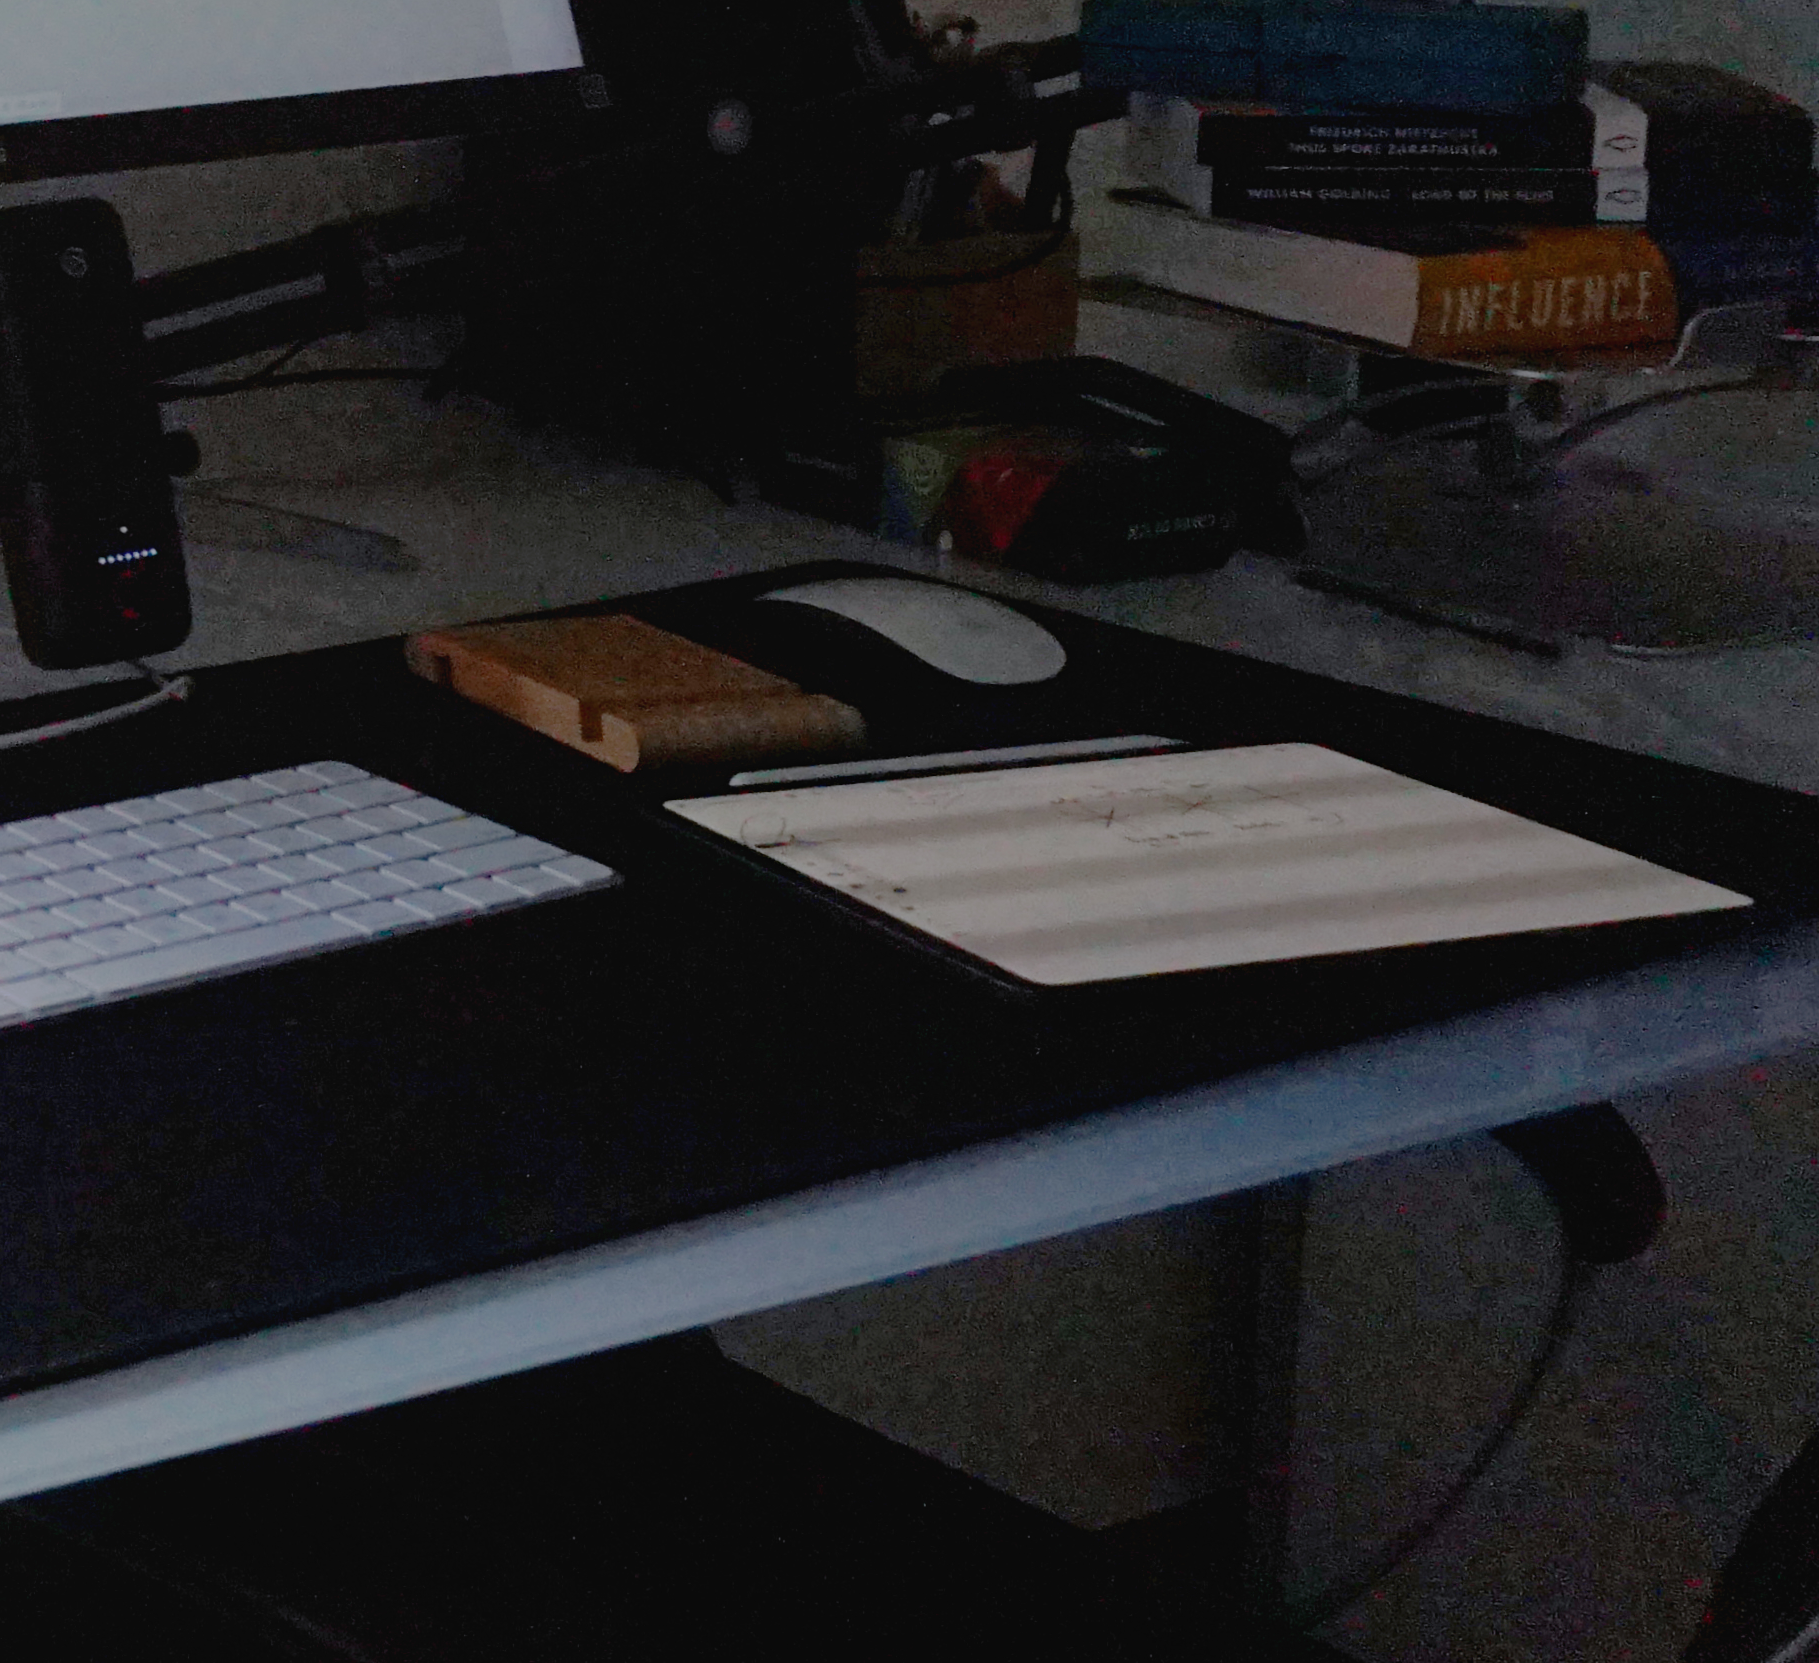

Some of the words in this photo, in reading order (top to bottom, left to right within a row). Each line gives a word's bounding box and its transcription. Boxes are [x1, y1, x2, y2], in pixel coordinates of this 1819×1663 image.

[1331, 142, 1381, 155] SPOKE
[1246, 188, 1314, 200] WILLIAM
[1317, 188, 1391, 200] GOLDING
[1411, 189, 1452, 201] LORD
[1484, 188, 1510, 202] THE
[1438, 269, 1653, 337] INFLUENCE
